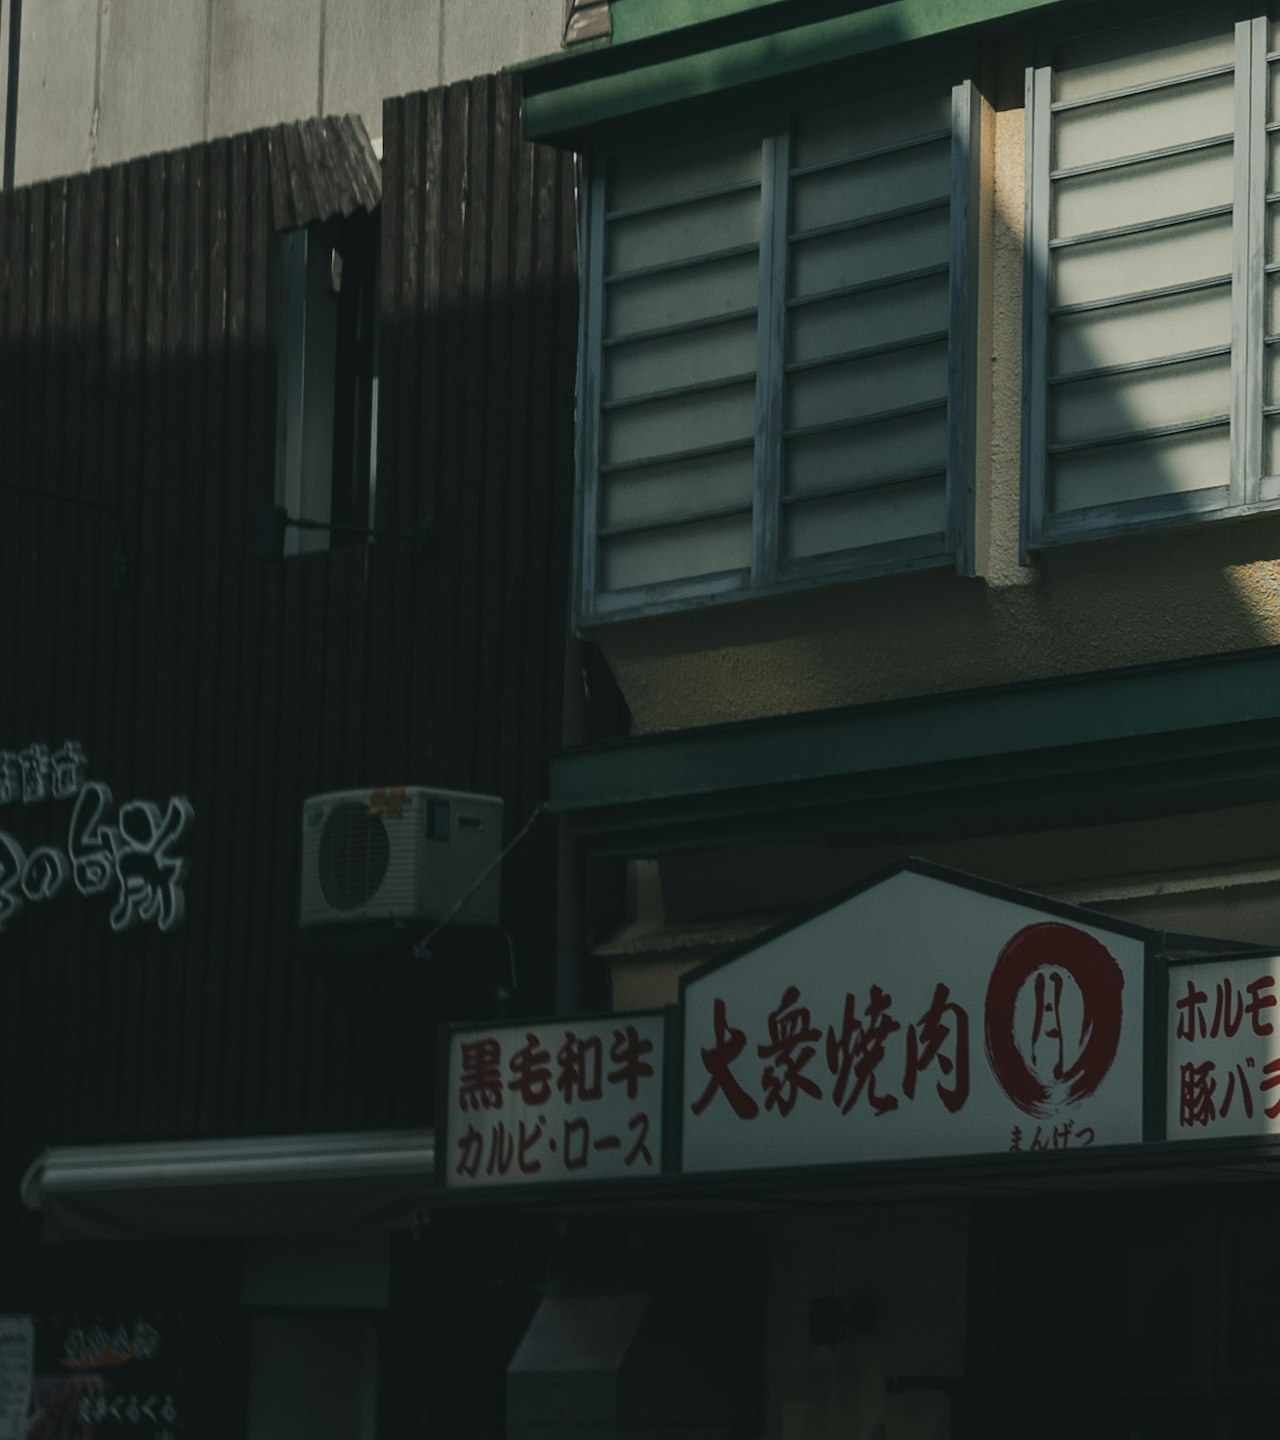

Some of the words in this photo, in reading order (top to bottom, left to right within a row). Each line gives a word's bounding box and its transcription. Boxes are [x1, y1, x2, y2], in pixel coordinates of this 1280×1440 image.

[459, 1025, 654, 1112] 黒毛和牛
[691, 982, 970, 1121] 大衆焼肉
[456, 1113, 653, 1178] カルビ・ロース
[1008, 1120, 1095, 1153] まんげつ
